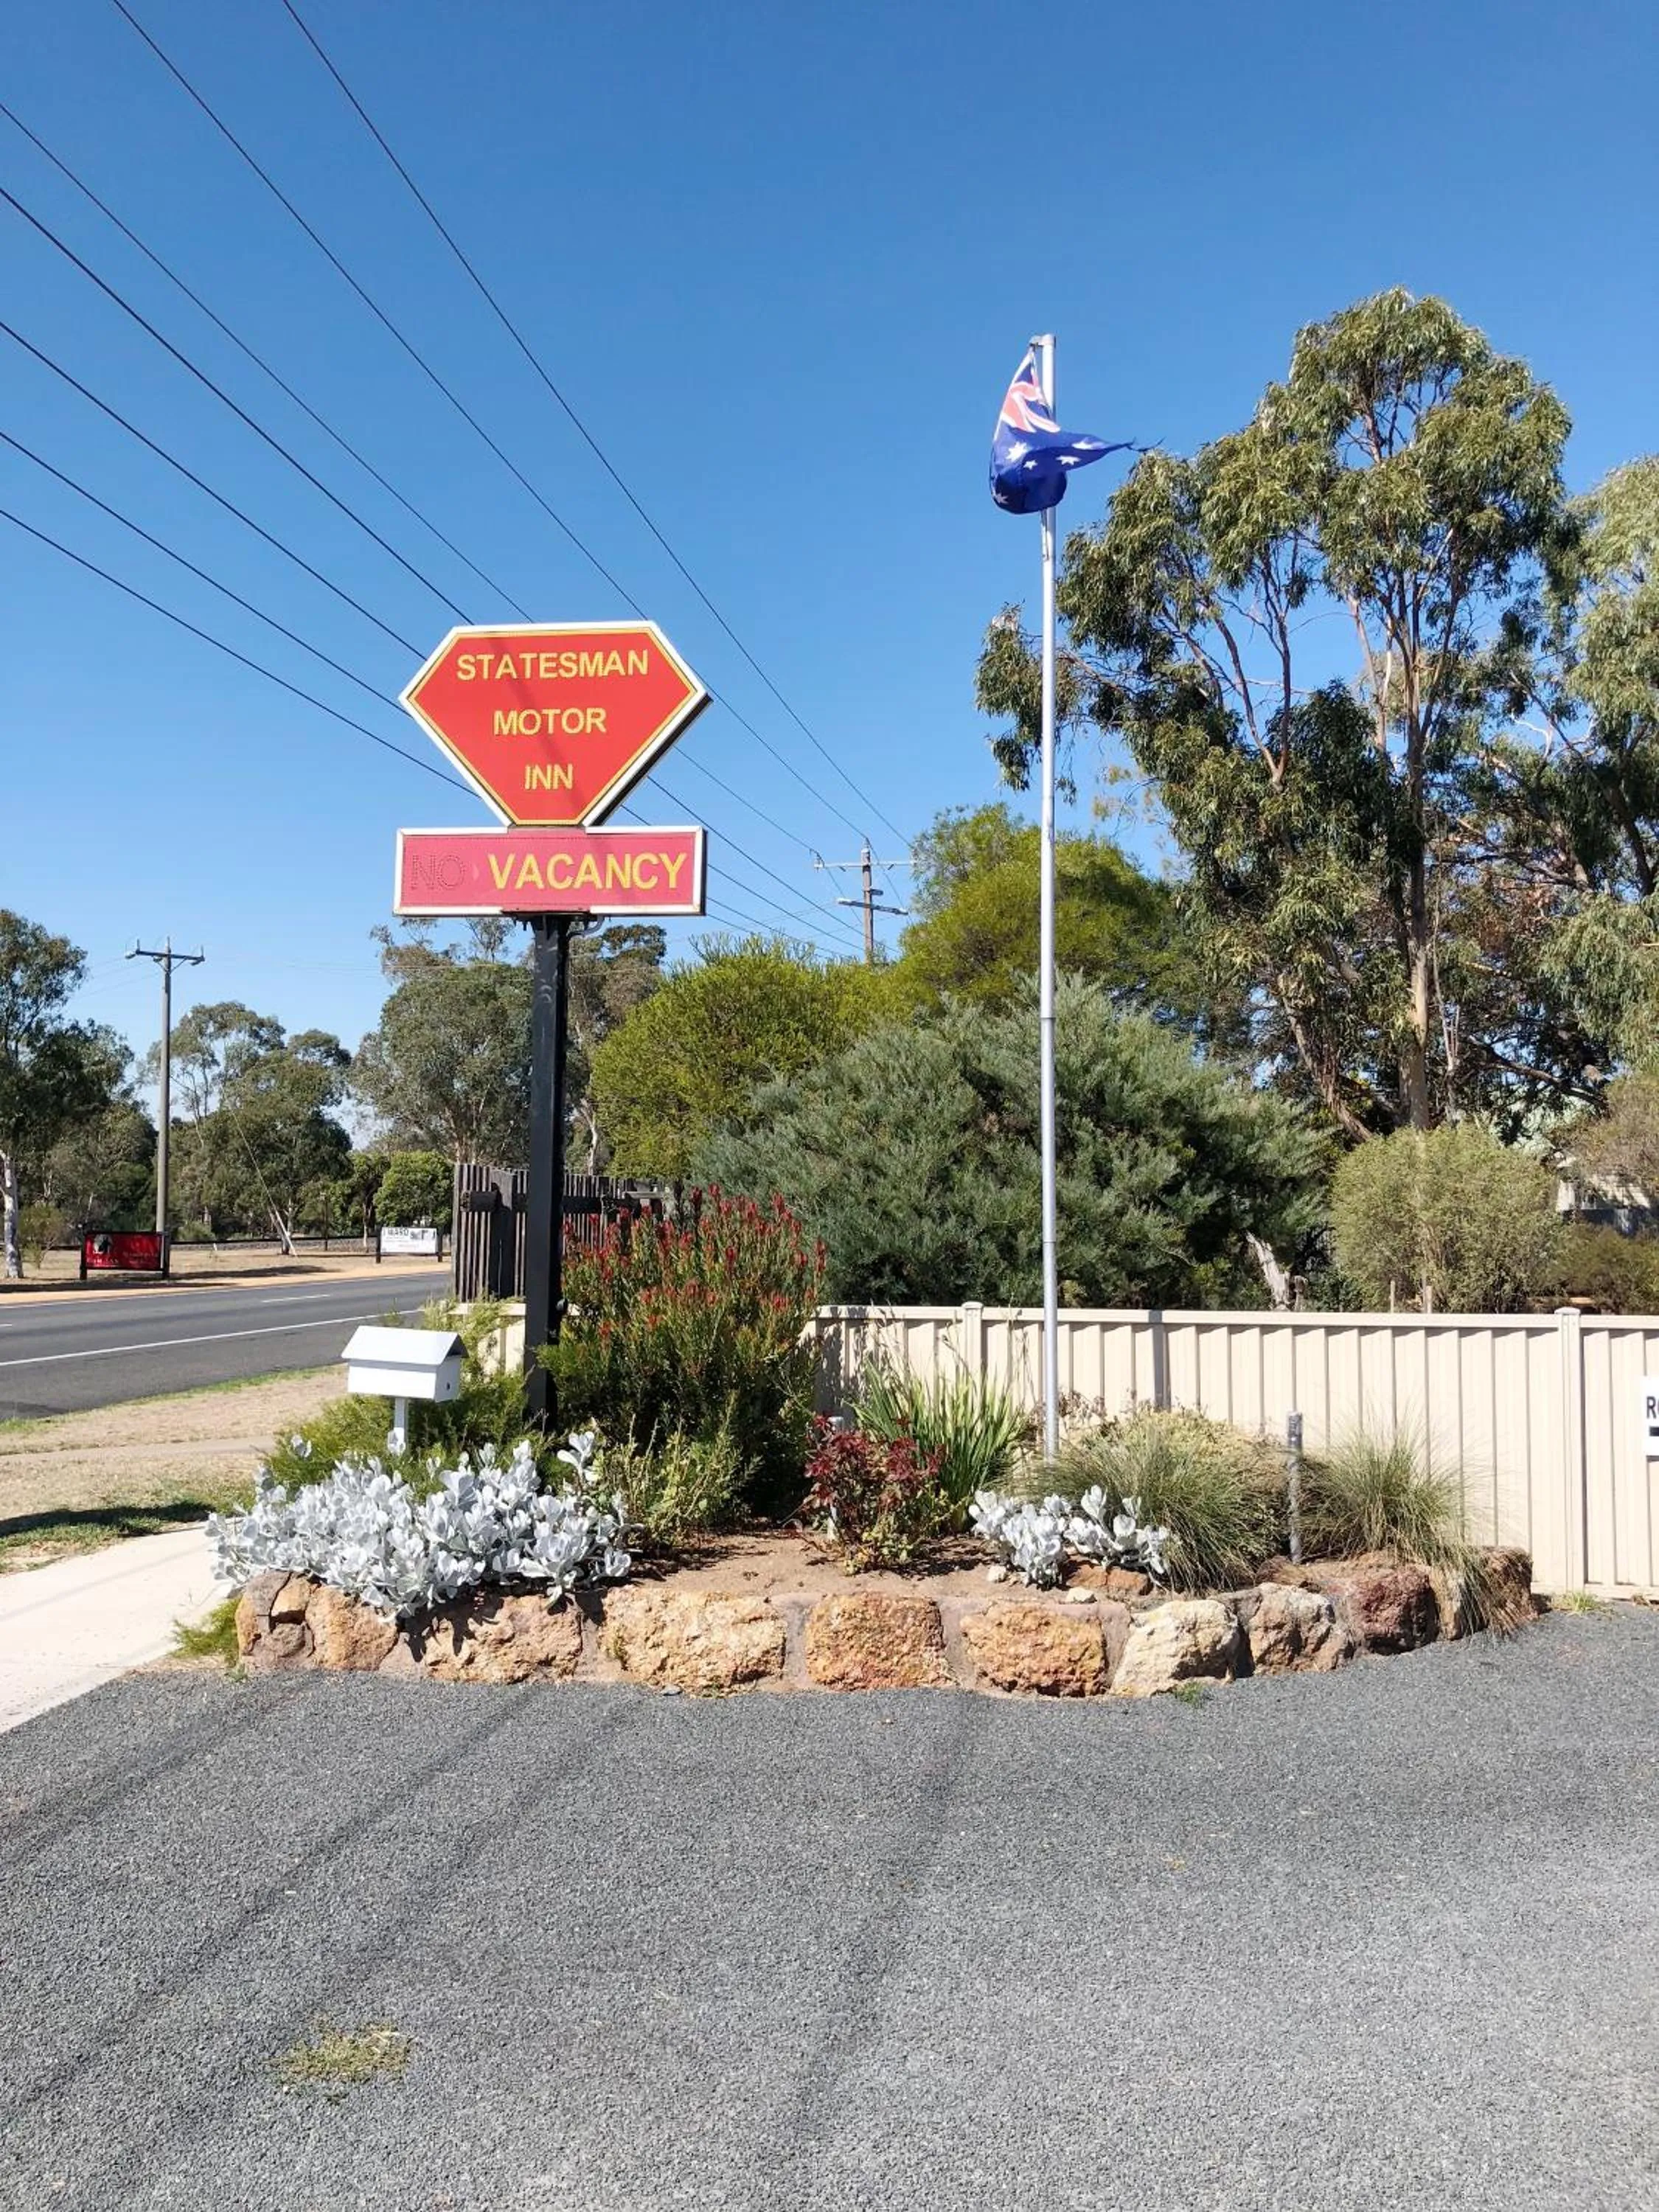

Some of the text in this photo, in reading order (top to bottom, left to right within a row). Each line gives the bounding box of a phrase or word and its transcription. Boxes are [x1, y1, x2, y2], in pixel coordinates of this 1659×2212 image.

[456, 650, 649, 681] STATESMAN
[493, 708, 606, 736] MOTOR
[524, 764, 574, 790] INN
[411, 852, 687, 890] NO VACANCY
[1646, 1396, 1659, 1419] R
